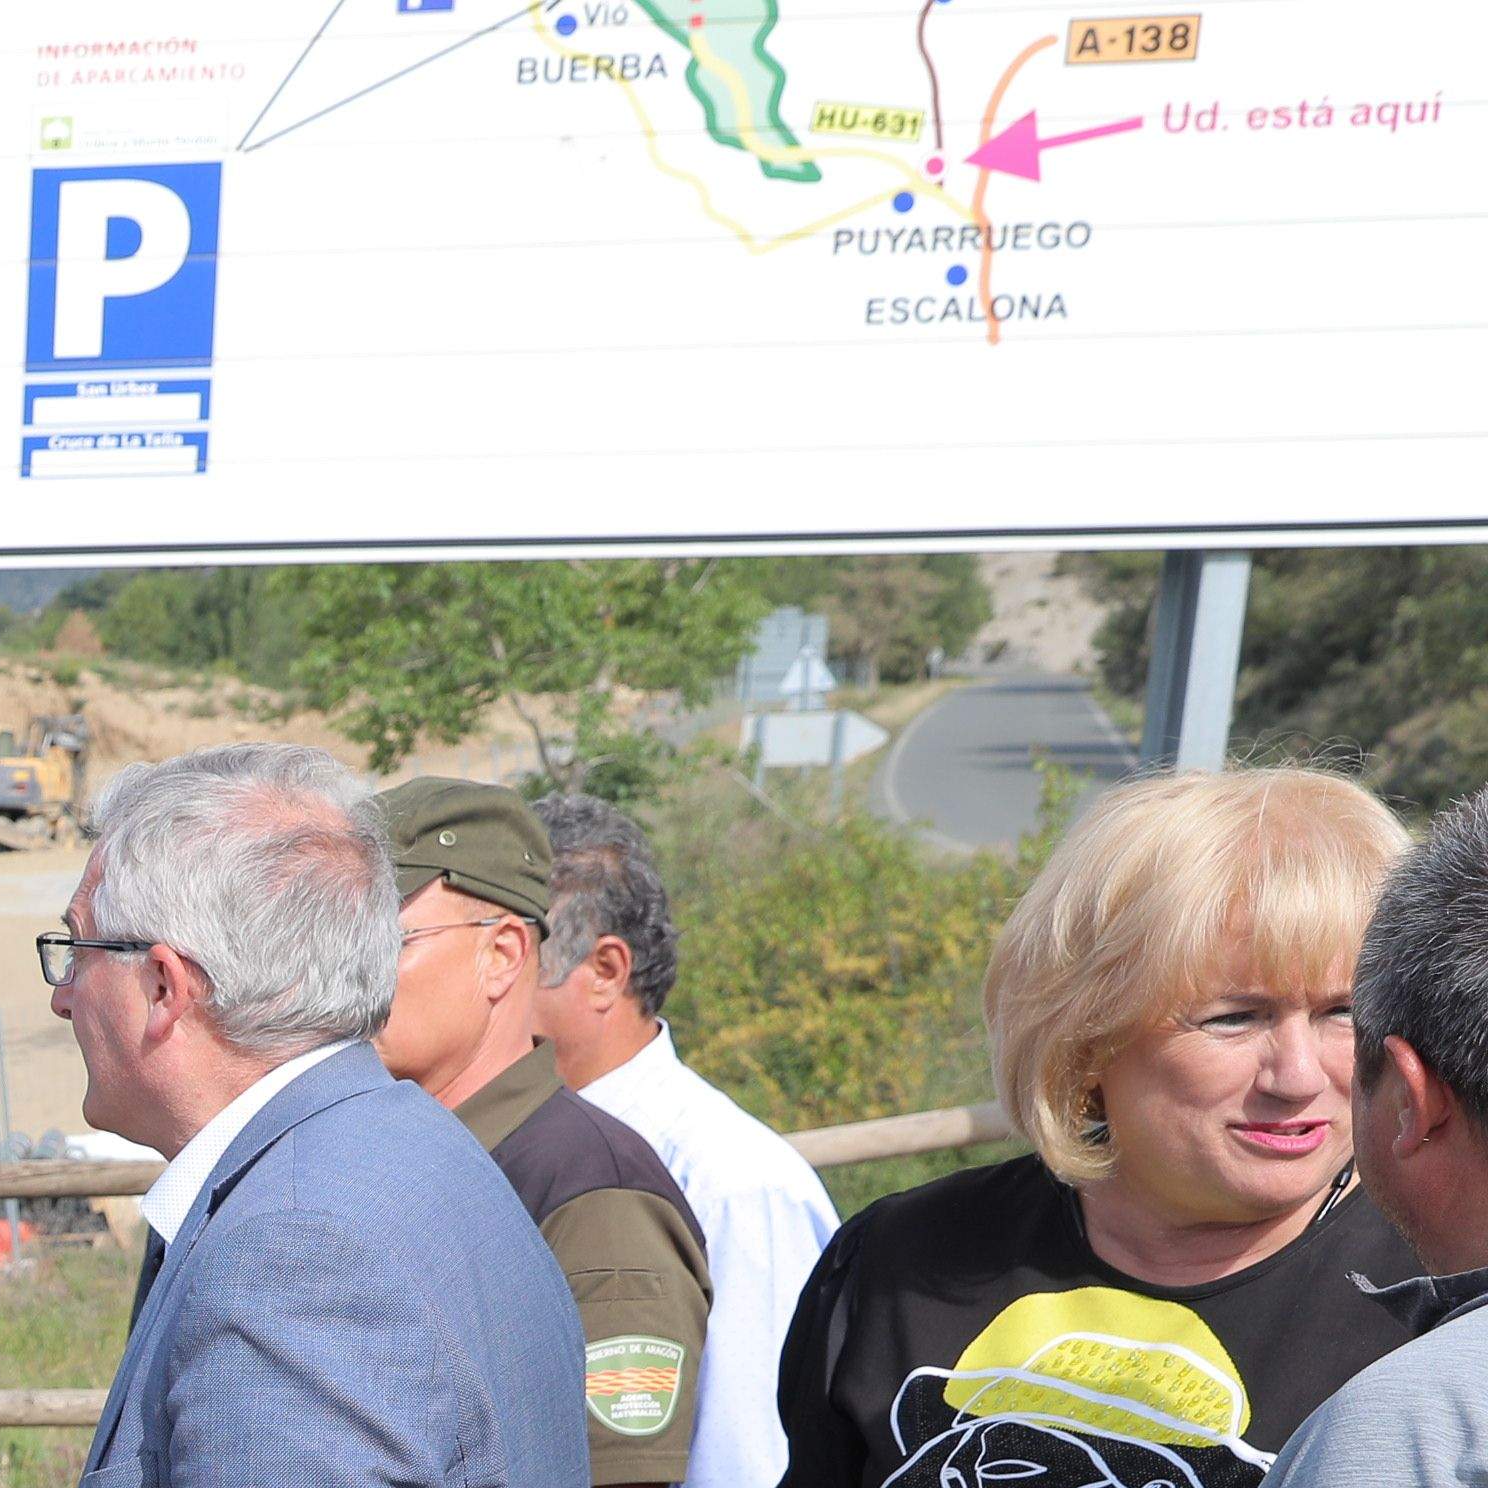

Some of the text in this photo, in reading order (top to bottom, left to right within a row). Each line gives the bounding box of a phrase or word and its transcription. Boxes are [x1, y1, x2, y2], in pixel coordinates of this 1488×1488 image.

[36, 36, 198, 59] INFORMACIÓN
[1075, 22, 1192, 56] A-138
[36, 62, 247, 87] DE APARCAMIENTO
[516, 53, 669, 84] BUERBA
[814, 106, 921, 137] HU-631
[1162, 90, 1443, 134] Ud. está aquí
[831, 220, 1093, 256] PUYARRUEGO
[53, 178, 191, 360] P
[864, 293, 1069, 326] ESCALONA
